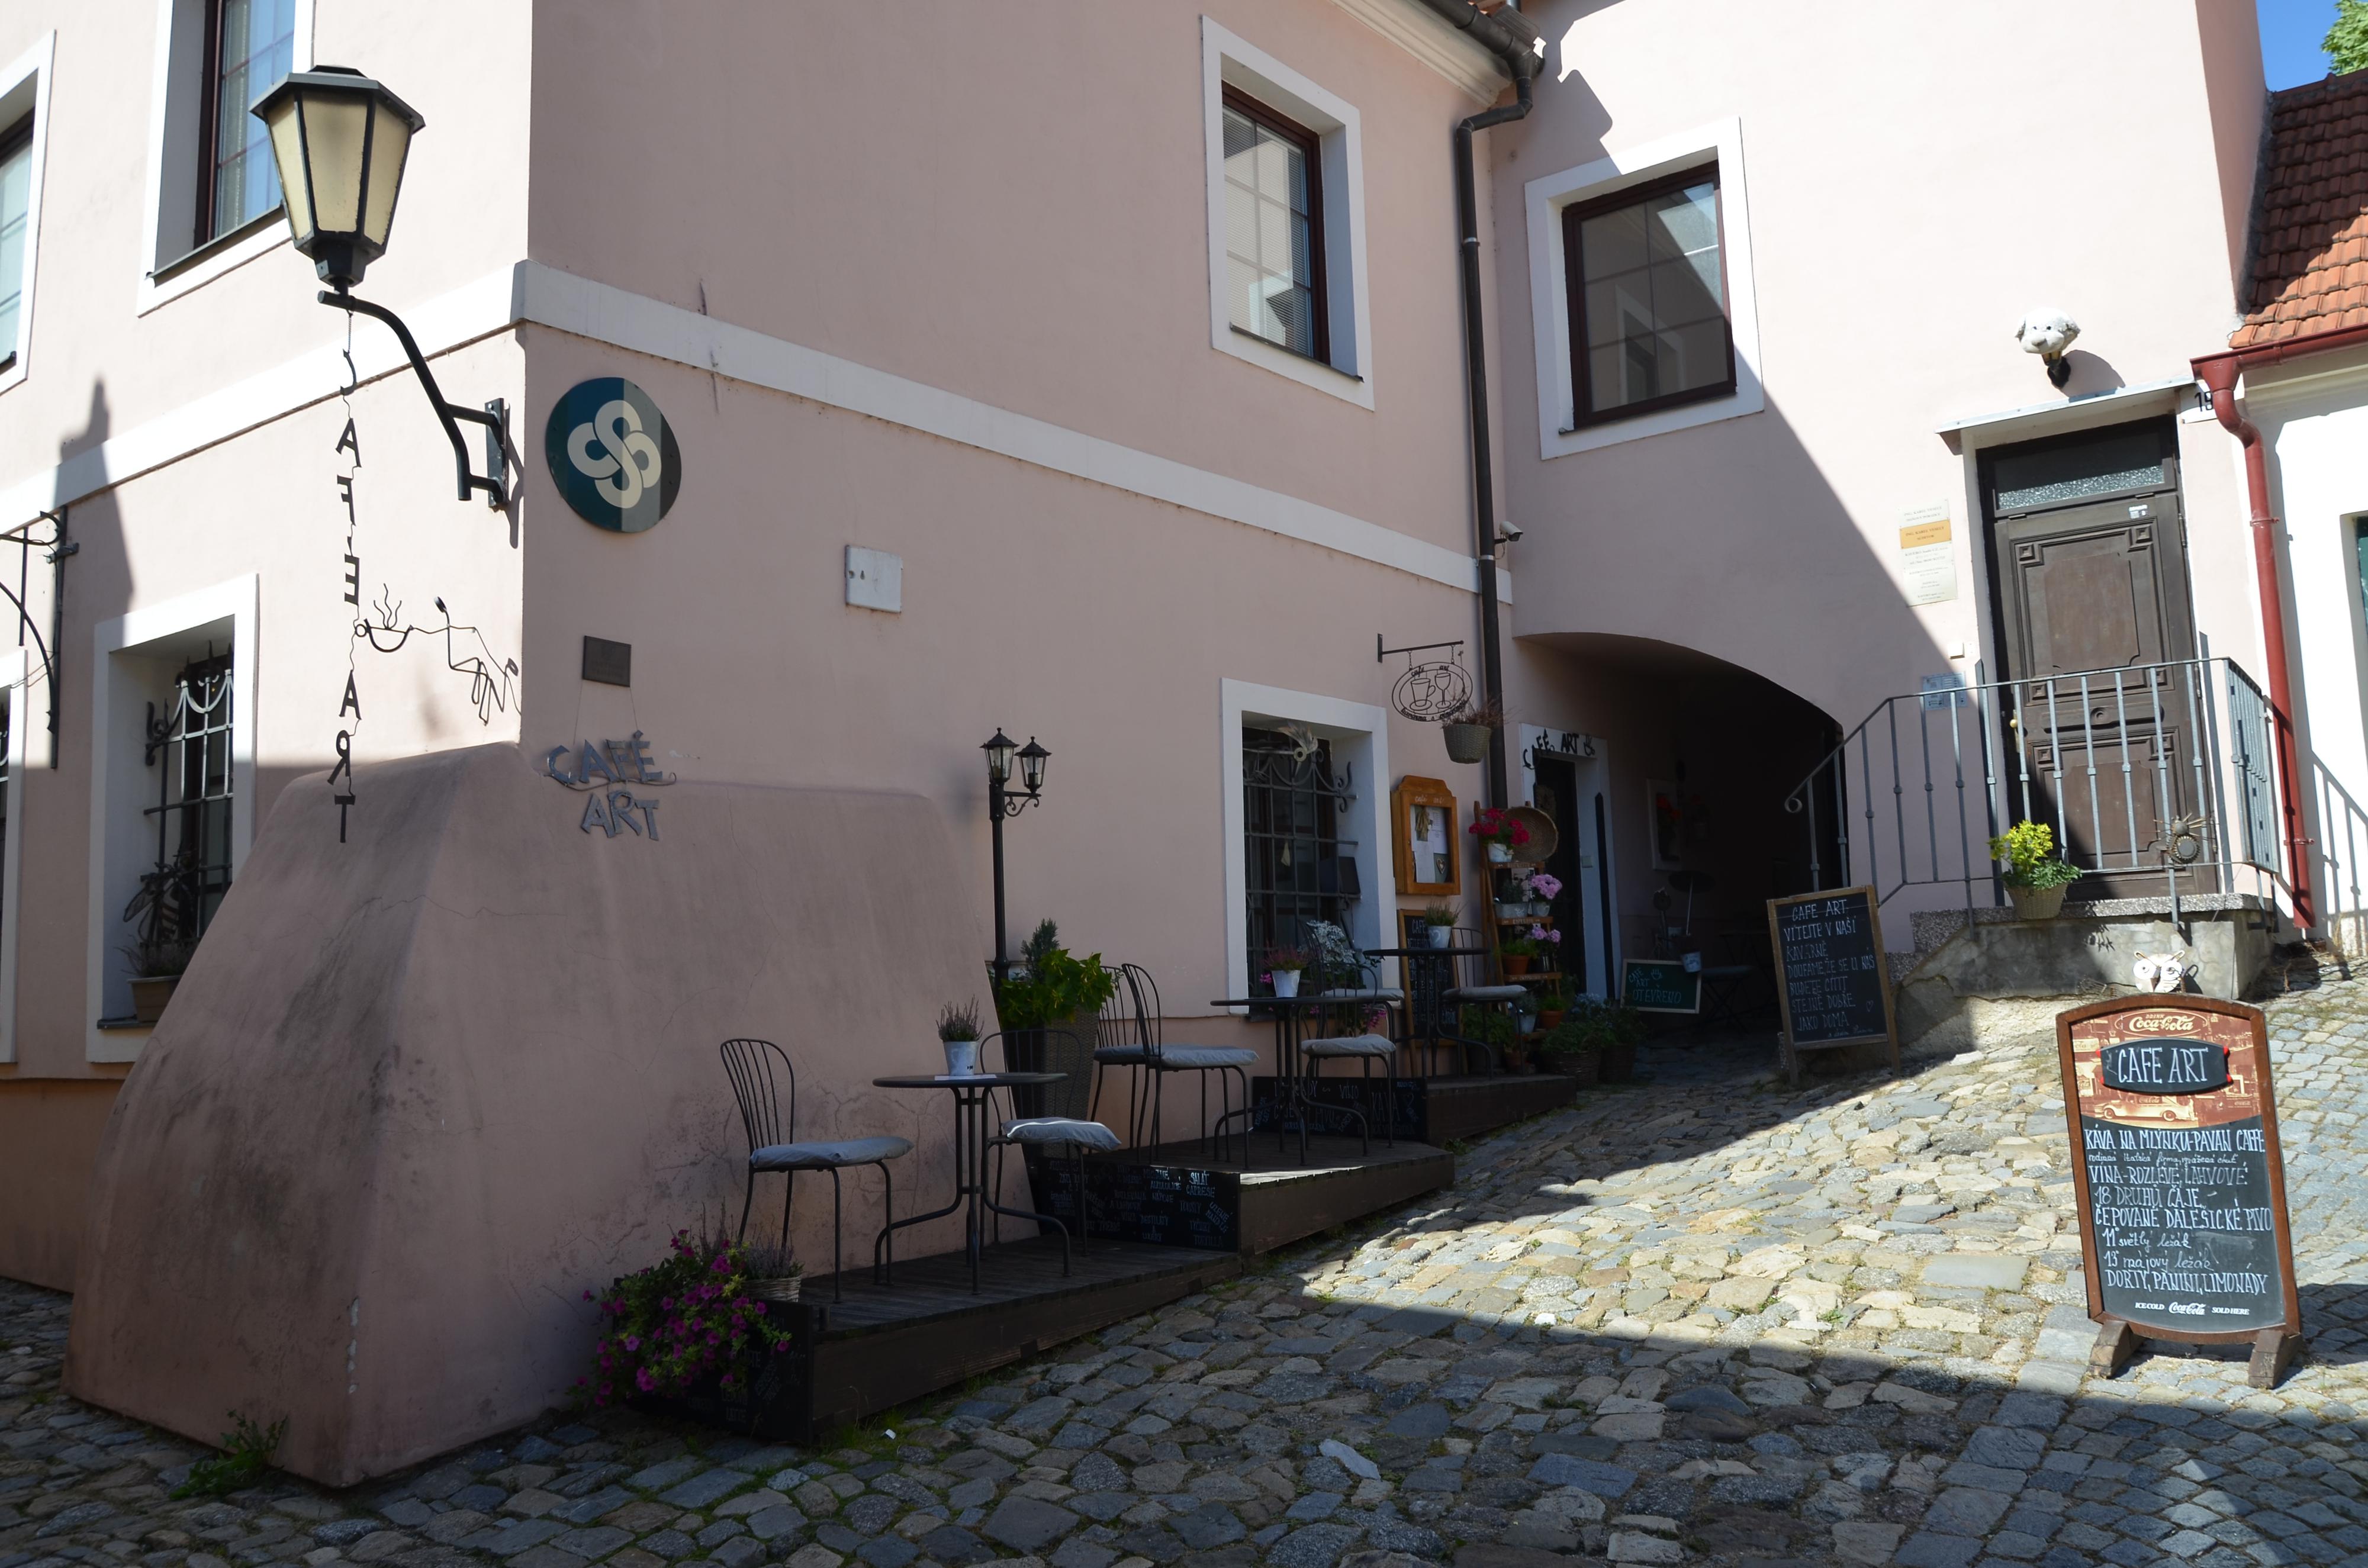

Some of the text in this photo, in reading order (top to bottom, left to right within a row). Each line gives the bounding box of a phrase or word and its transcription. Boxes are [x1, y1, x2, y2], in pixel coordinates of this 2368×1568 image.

[2195, 391, 2213, 412] 19
[1411, 665, 1424, 677] café
[1561, 733, 1579, 754] ART
[547, 730, 663, 785] CAFÉ
[581, 790, 659, 841] ART
[1792, 899, 1847, 922] CAFE ART
[1783, 922, 1822, 942] VÍTEJTE
[1825, 922, 1832, 936] V
[1839, 958, 1847, 971] SE
[1851, 957, 1858, 971] U
[1636, 978, 1650, 987] ART
[1797, 1012, 1850, 1031] JAKO DOMA
[2129, 1015, 2195, 1032] Coca-Cola
[2118, 1047, 2209, 1084] CAFE ART
[2084, 1123, 2117, 1150] KÁVA
[2118, 1130, 2137, 1150] NA
[2236, 1128, 2266, 1152] CAFFE
[1186, 1184, 1215, 1198] CAPRESE
[2094, 1186, 2112, 1204] 18
[2114, 1184, 2163, 1208] DRUHŮ
[2095, 1198, 2272, 1231] ČEPOVANÉ DALEŠICKÉ PIVO
[2118, 1231, 2151, 1253] světlý
[2157, 1232, 2192, 1249] ležák
